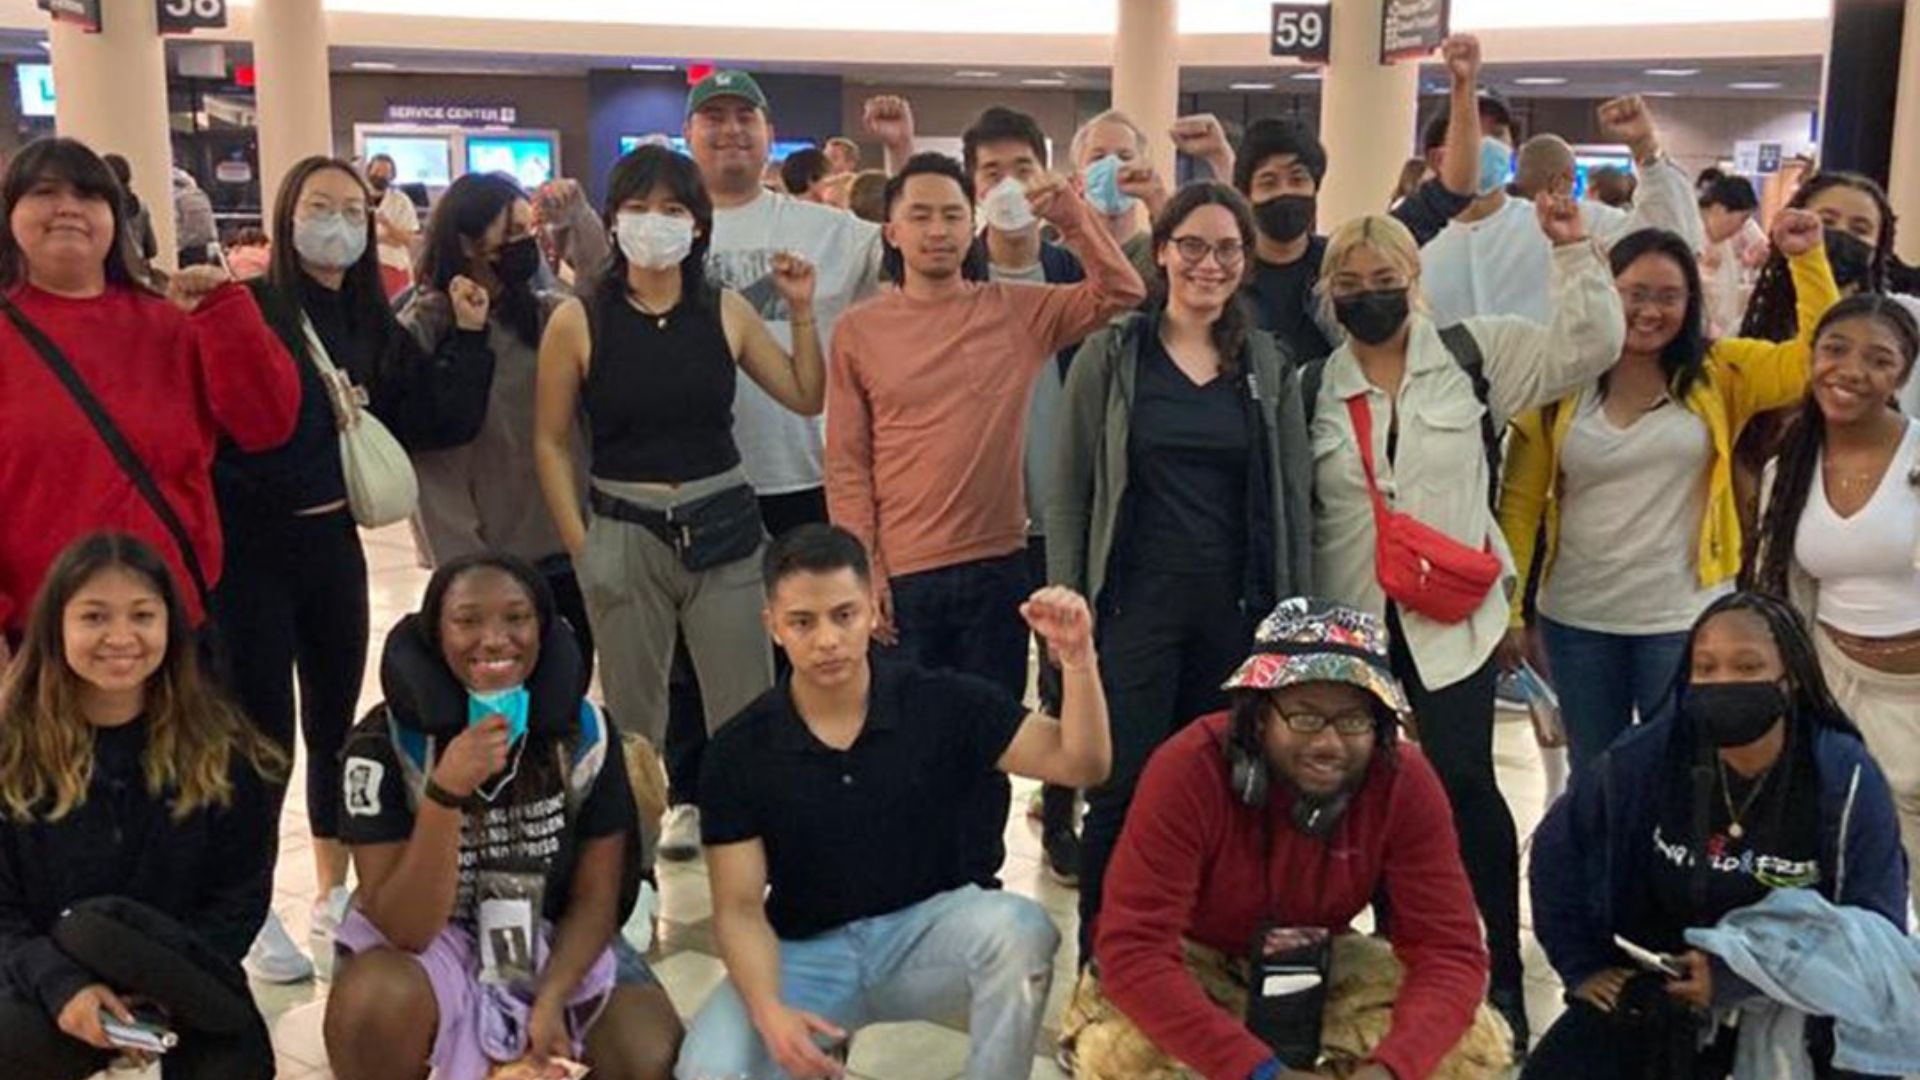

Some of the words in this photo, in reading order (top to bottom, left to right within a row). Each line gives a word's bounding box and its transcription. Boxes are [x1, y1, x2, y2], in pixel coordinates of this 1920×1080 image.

[1276, 11, 1323, 48] 59
[388, 106, 445, 119] SERVICE
[446, 106, 499, 121] CENTER
